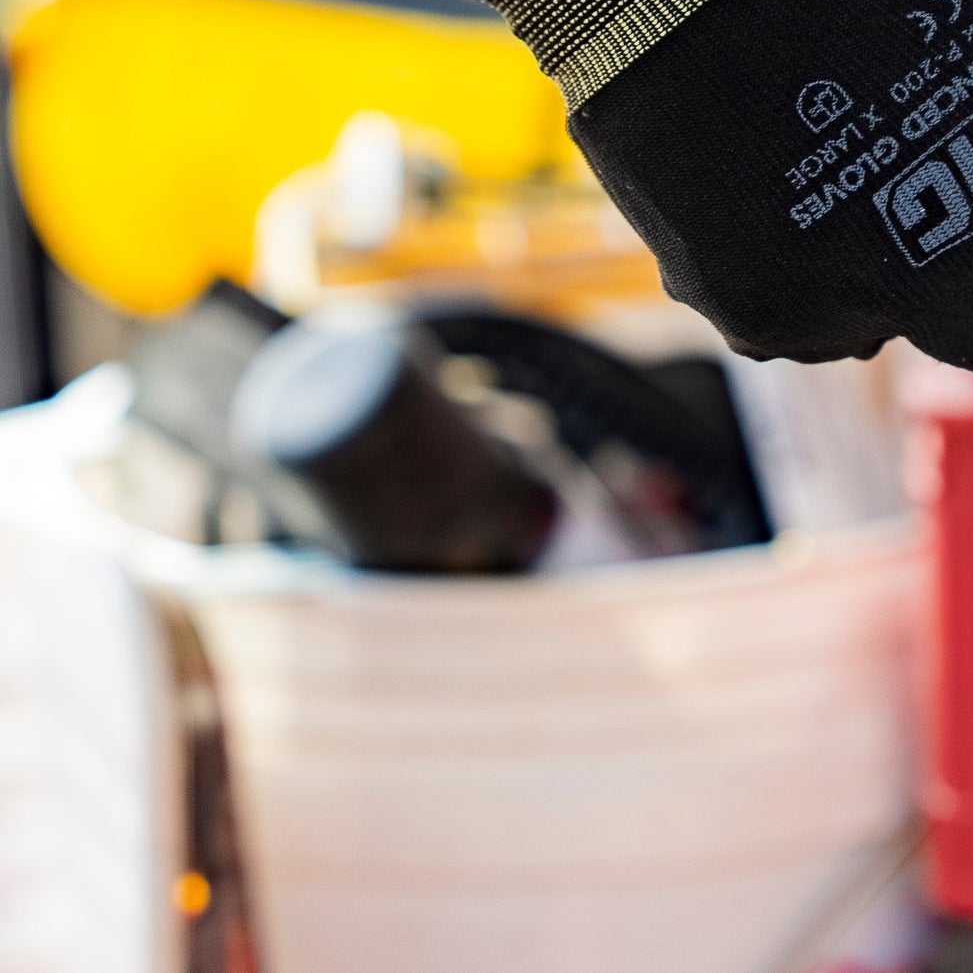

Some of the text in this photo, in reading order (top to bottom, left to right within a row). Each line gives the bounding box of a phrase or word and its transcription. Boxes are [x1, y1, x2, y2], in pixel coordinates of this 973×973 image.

[889, 39, 963, 104] P-200
[859, 103, 885, 130] X
[784, 123, 864, 189] LARGE
[789, 135, 900, 229] GLOVES
